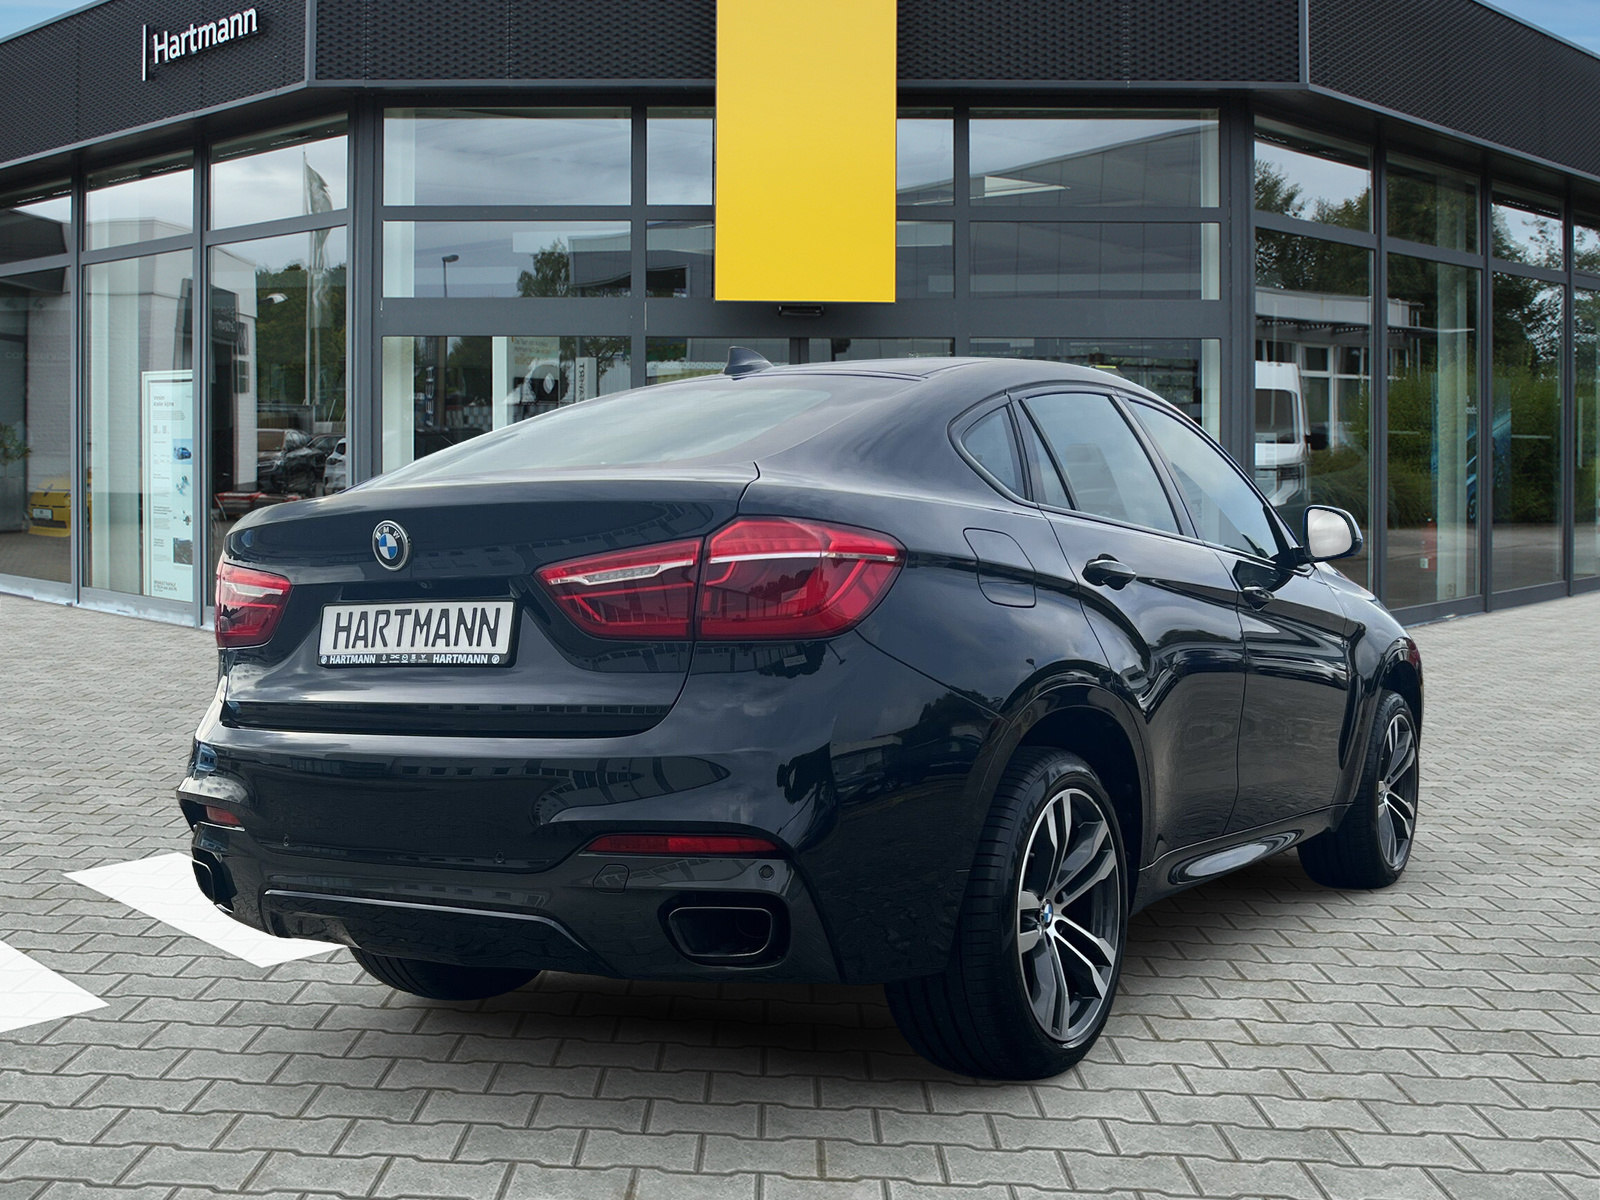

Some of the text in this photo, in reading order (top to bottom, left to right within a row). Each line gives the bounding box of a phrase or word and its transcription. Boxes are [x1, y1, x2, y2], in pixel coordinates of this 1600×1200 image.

[152, 7, 258, 64] Hartmann
[375, 526, 401, 541] BMW
[332, 606, 502, 650] HARTMANN
[329, 653, 488, 665] HARTMANN HARTMANN
